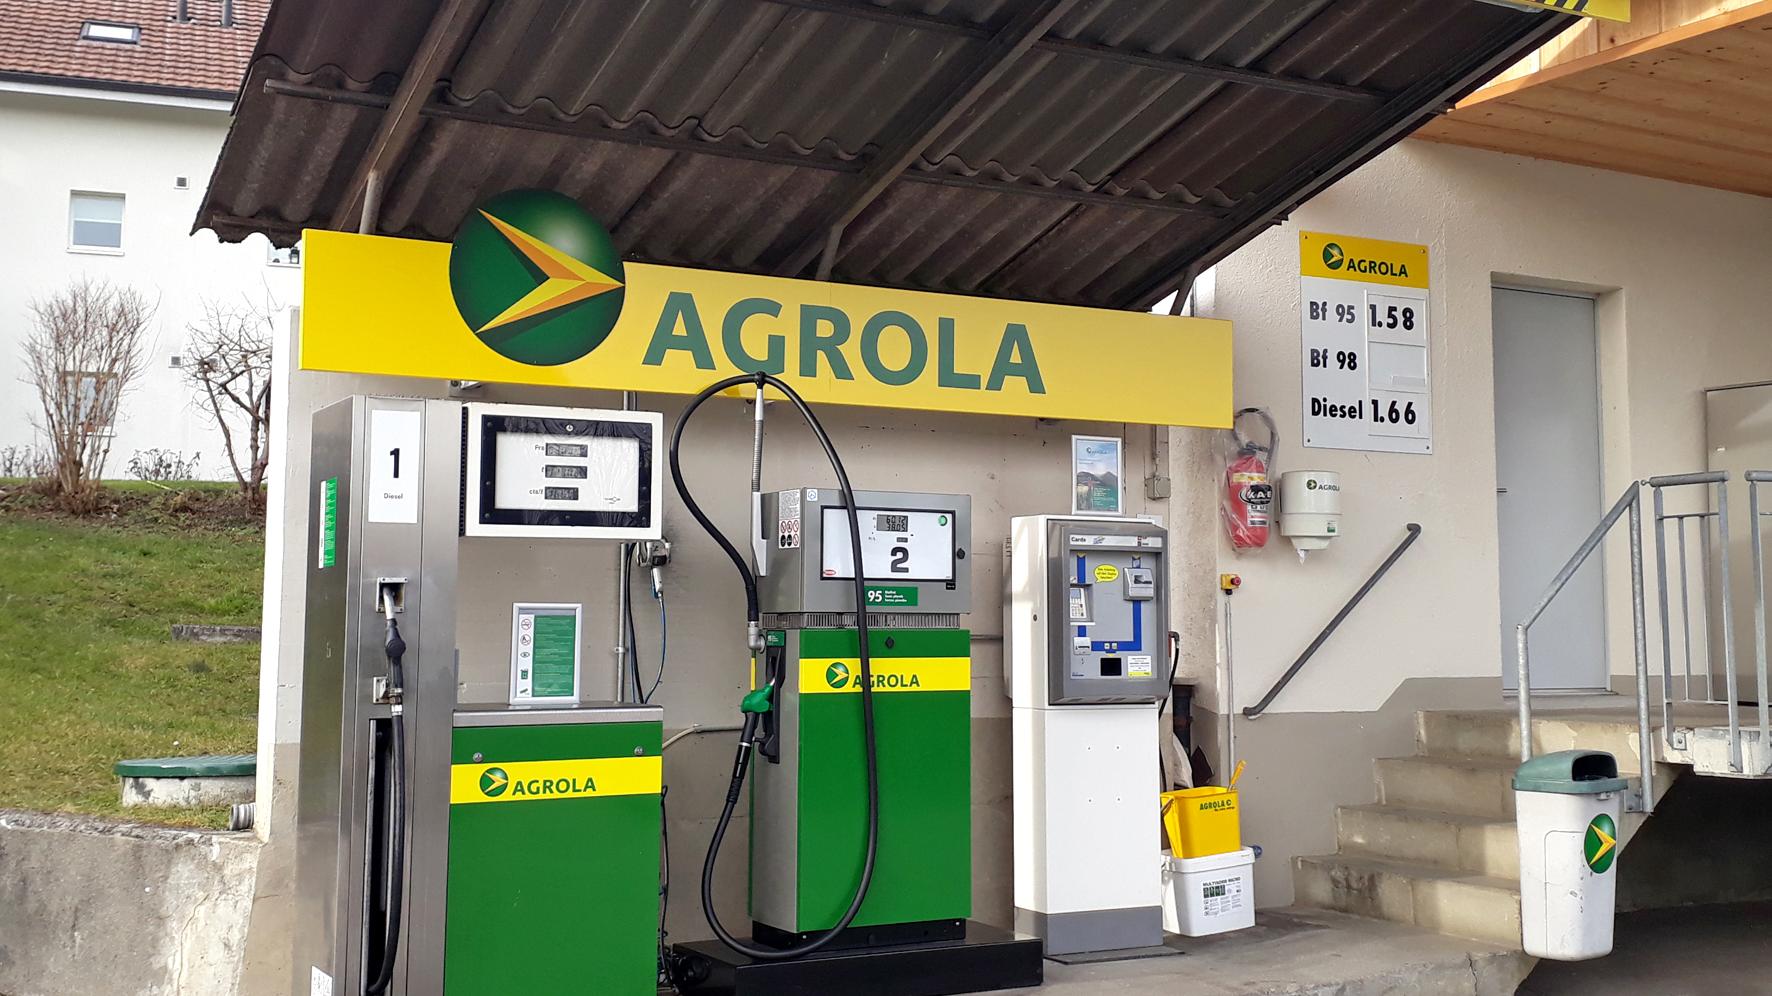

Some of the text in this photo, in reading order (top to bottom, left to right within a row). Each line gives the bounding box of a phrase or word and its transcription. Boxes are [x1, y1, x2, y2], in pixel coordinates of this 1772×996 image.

[1346, 257, 1409, 278] AGROLA
[1309, 301, 1415, 331] Bf 95 1.58
[642, 291, 1047, 394] AGROLA
[1309, 348, 1358, 371] Bf 98
[1310, 397, 1417, 425] Diesel 1.66
[389, 447, 401, 479] 1
[890, 546, 910, 573] 2
[867, 590, 883, 603] 95
[512, 777, 597, 796] AGROLA
[1199, 799, 1225, 811] AGROLA
